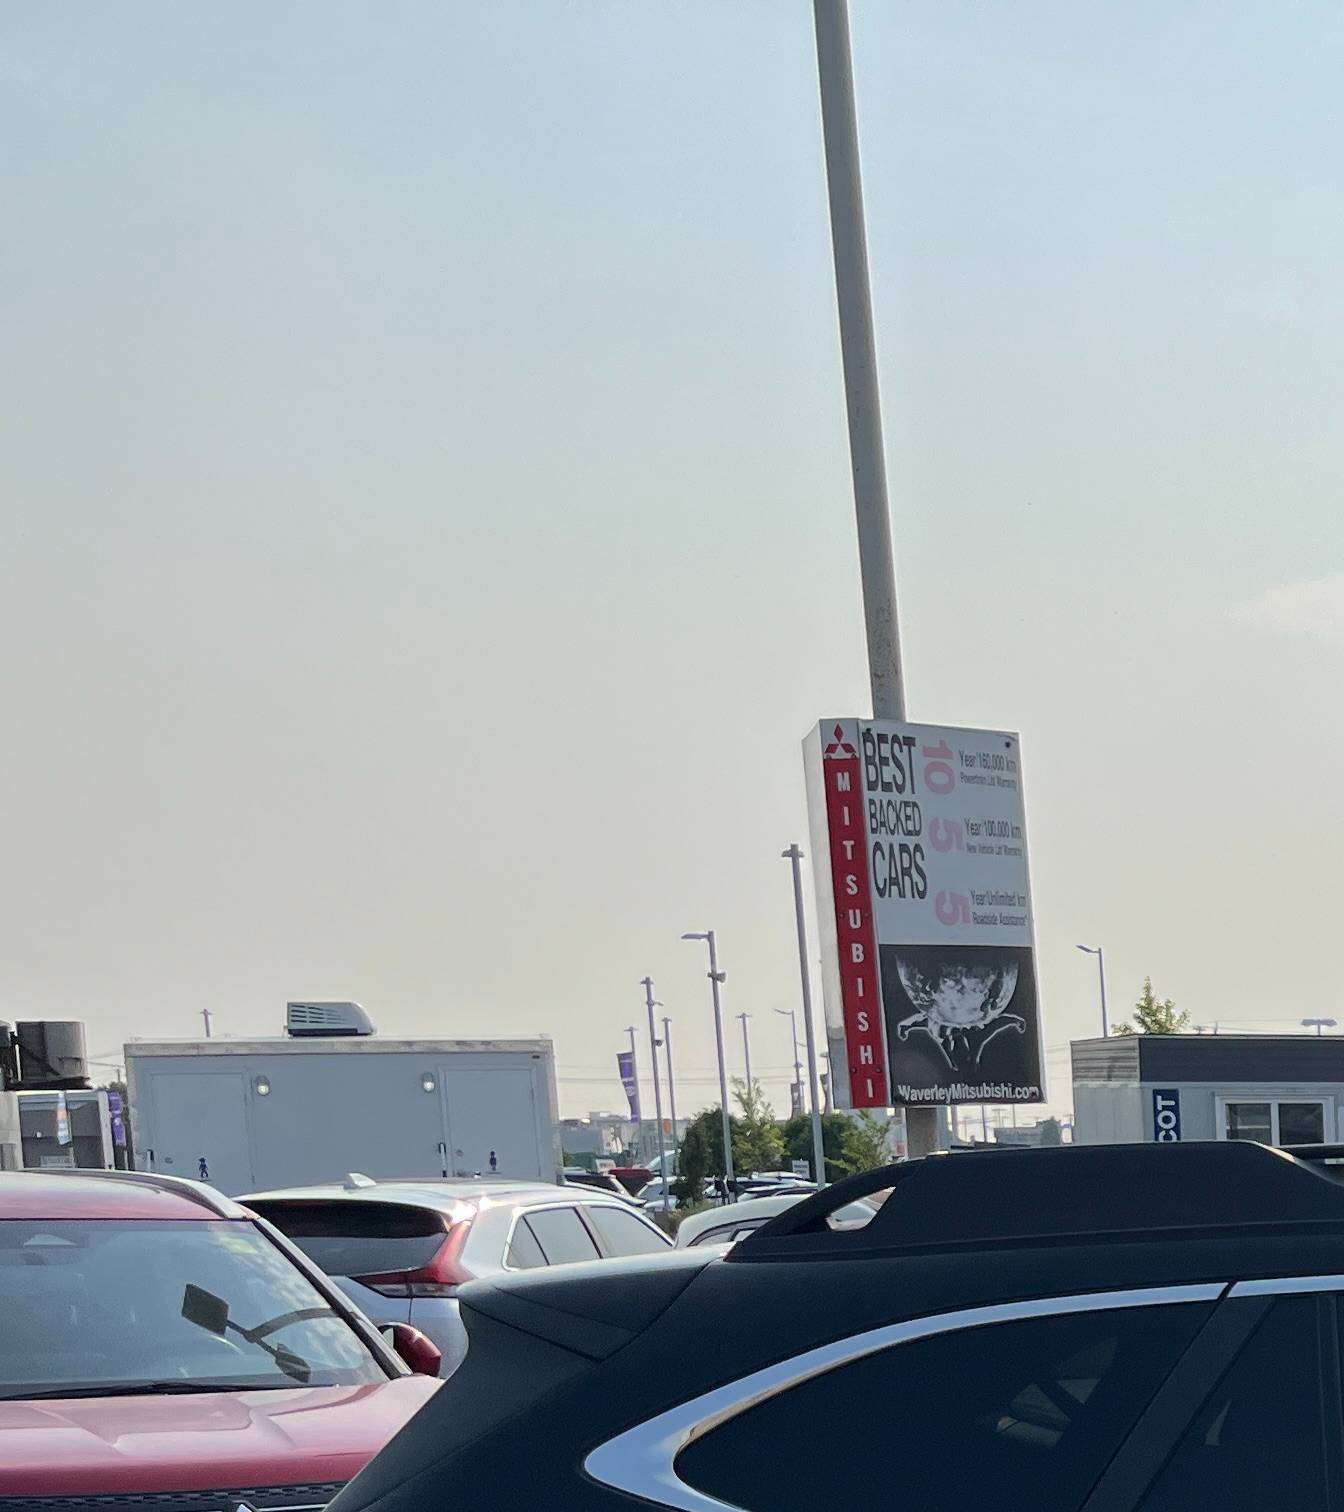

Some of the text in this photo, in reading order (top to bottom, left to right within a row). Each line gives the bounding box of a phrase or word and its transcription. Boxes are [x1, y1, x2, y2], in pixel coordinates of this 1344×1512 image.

[862, 732, 916, 794] BEST
[922, 739, 955, 795] 10
[869, 799, 922, 837] BACKED
[928, 817, 964, 853] 5
[873, 841, 928, 899] CARS
[935, 890, 972, 926] 5
[836, 771, 874, 1098] MITSUBISHI
[898, 1082, 1039, 1103] WaverleyMitsubishi.com
